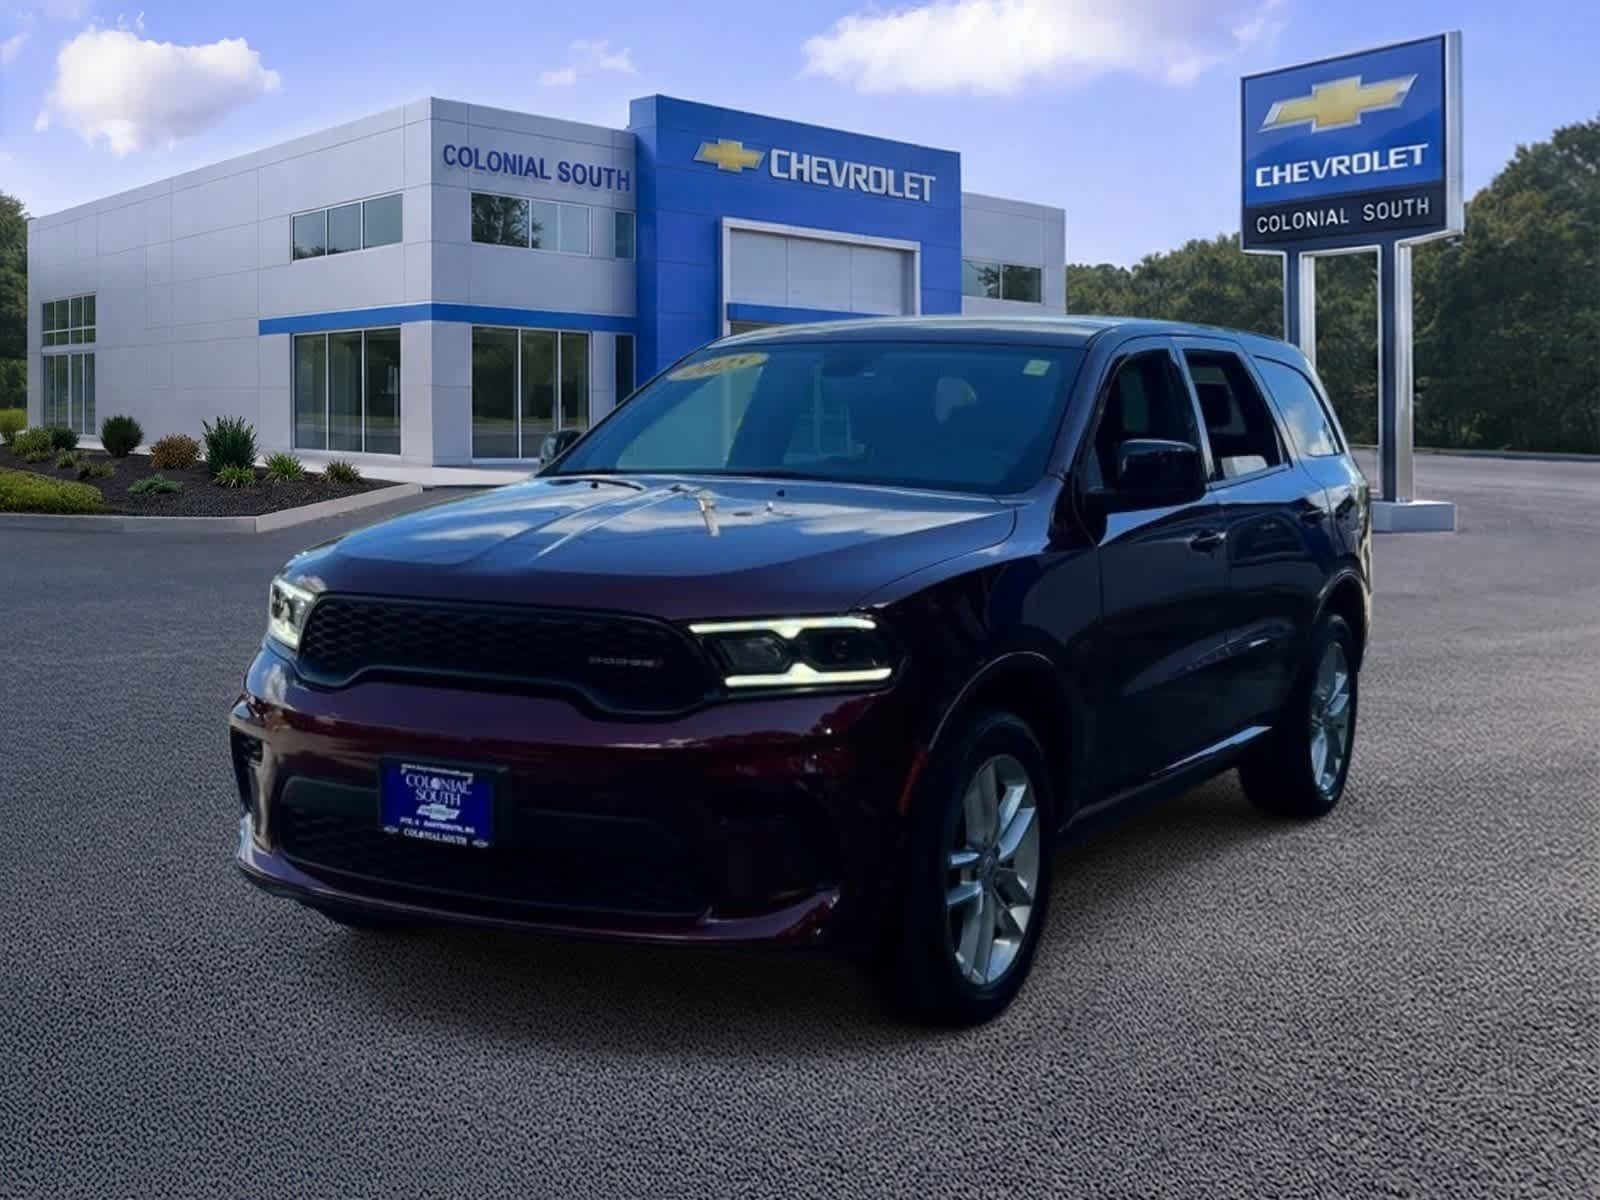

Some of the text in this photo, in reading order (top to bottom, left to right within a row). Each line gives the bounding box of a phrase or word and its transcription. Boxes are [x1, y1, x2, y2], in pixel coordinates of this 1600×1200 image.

[443, 144, 631, 192] COLONIAL SOUTH
[769, 148, 937, 203] CHEVROLET
[1255, 143, 1429, 188] CHEVROLET
[1256, 197, 1430, 234] COLONIAL SOUTH
[405, 774, 473, 796] COLONIAL
[415, 788, 461, 807] SOUTH
